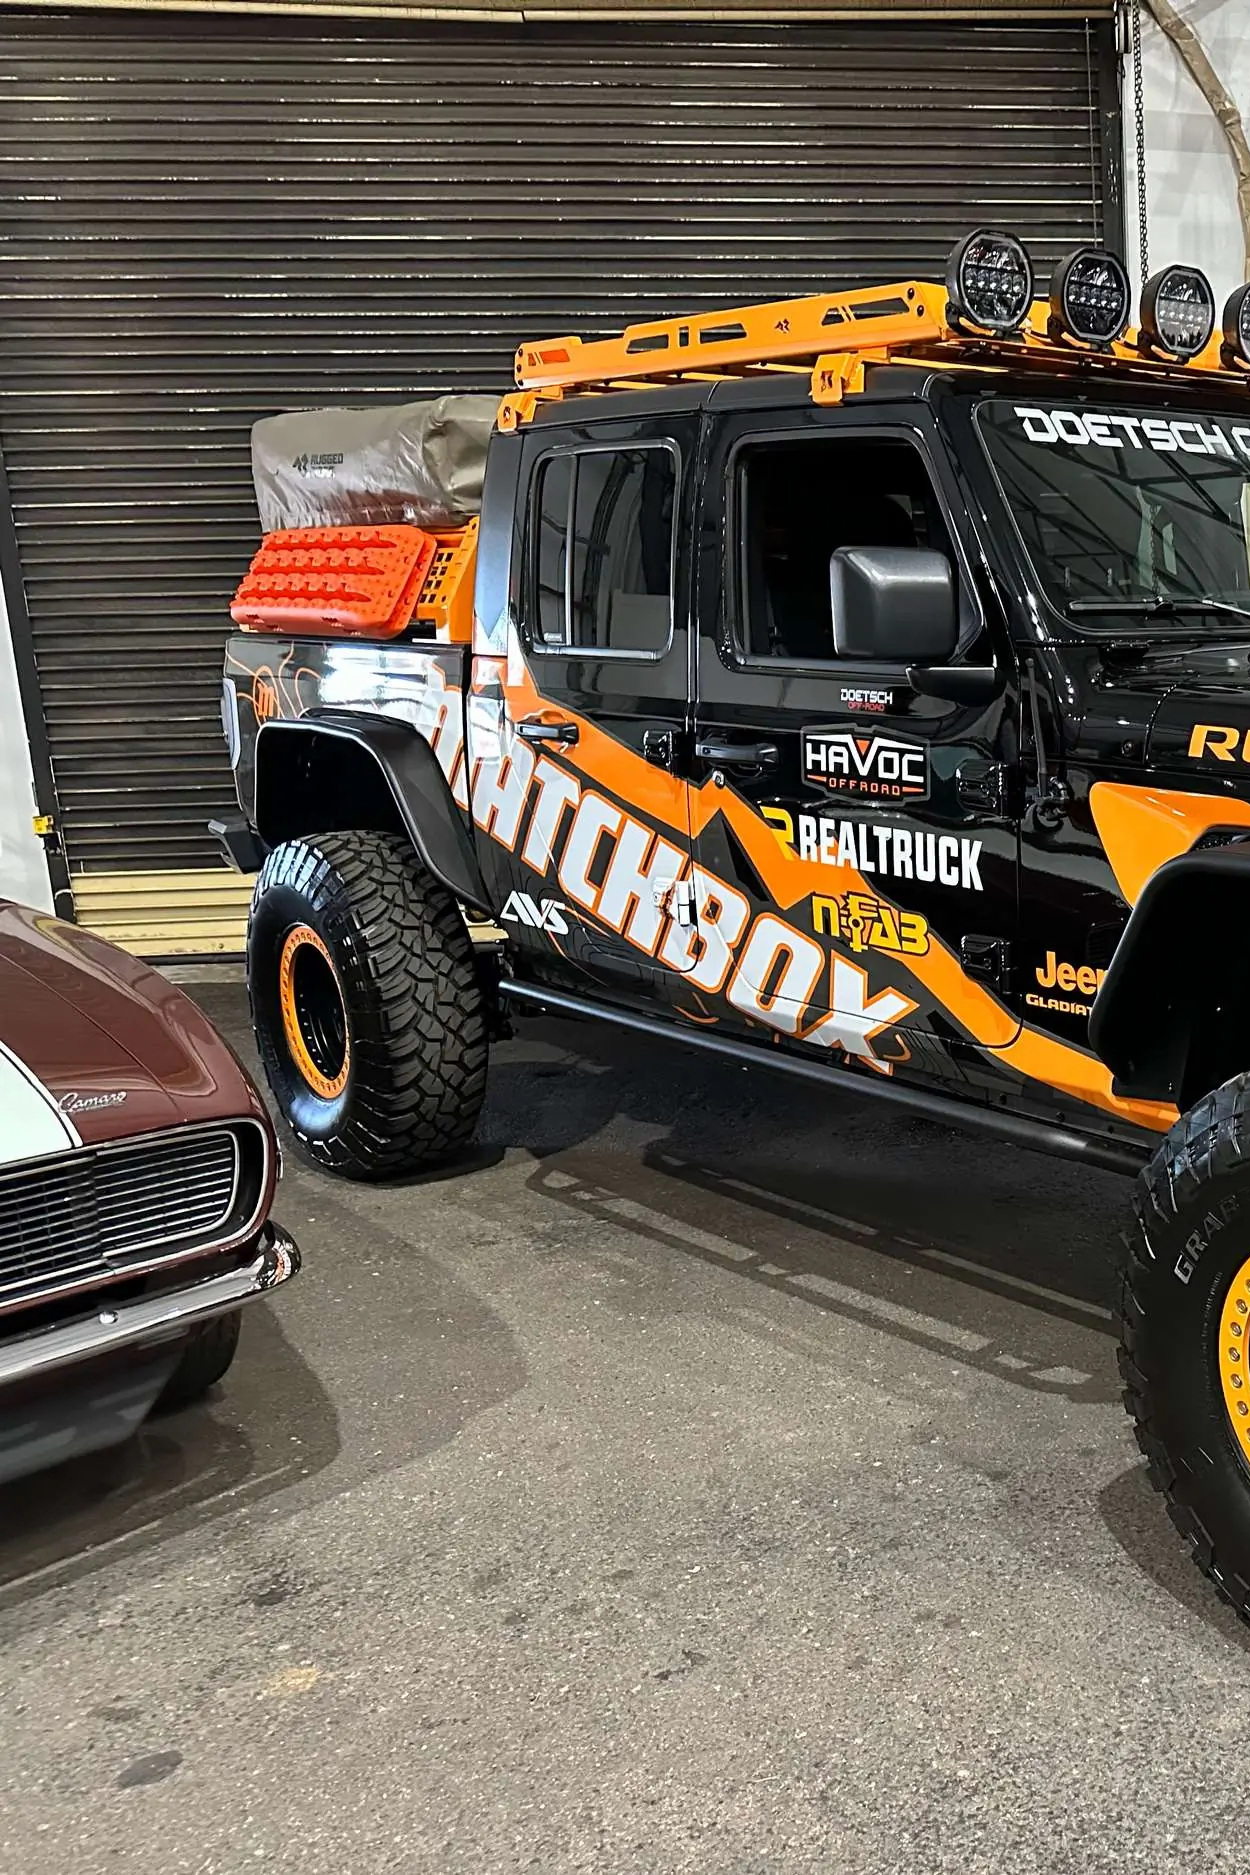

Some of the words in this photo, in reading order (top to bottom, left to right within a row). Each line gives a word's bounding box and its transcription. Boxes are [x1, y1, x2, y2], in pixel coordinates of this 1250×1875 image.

[1013, 406, 1233, 455] DOETSCH
[840, 688, 893, 705] DOETSCH
[805, 734, 924, 783] HAVOC
[828, 777, 901, 796] OFFROAD
[798, 814, 984, 891] REALTRUCK
[1025, 993, 1093, 1016] GLADIAT
[58, 1091, 127, 1113] Camaro
